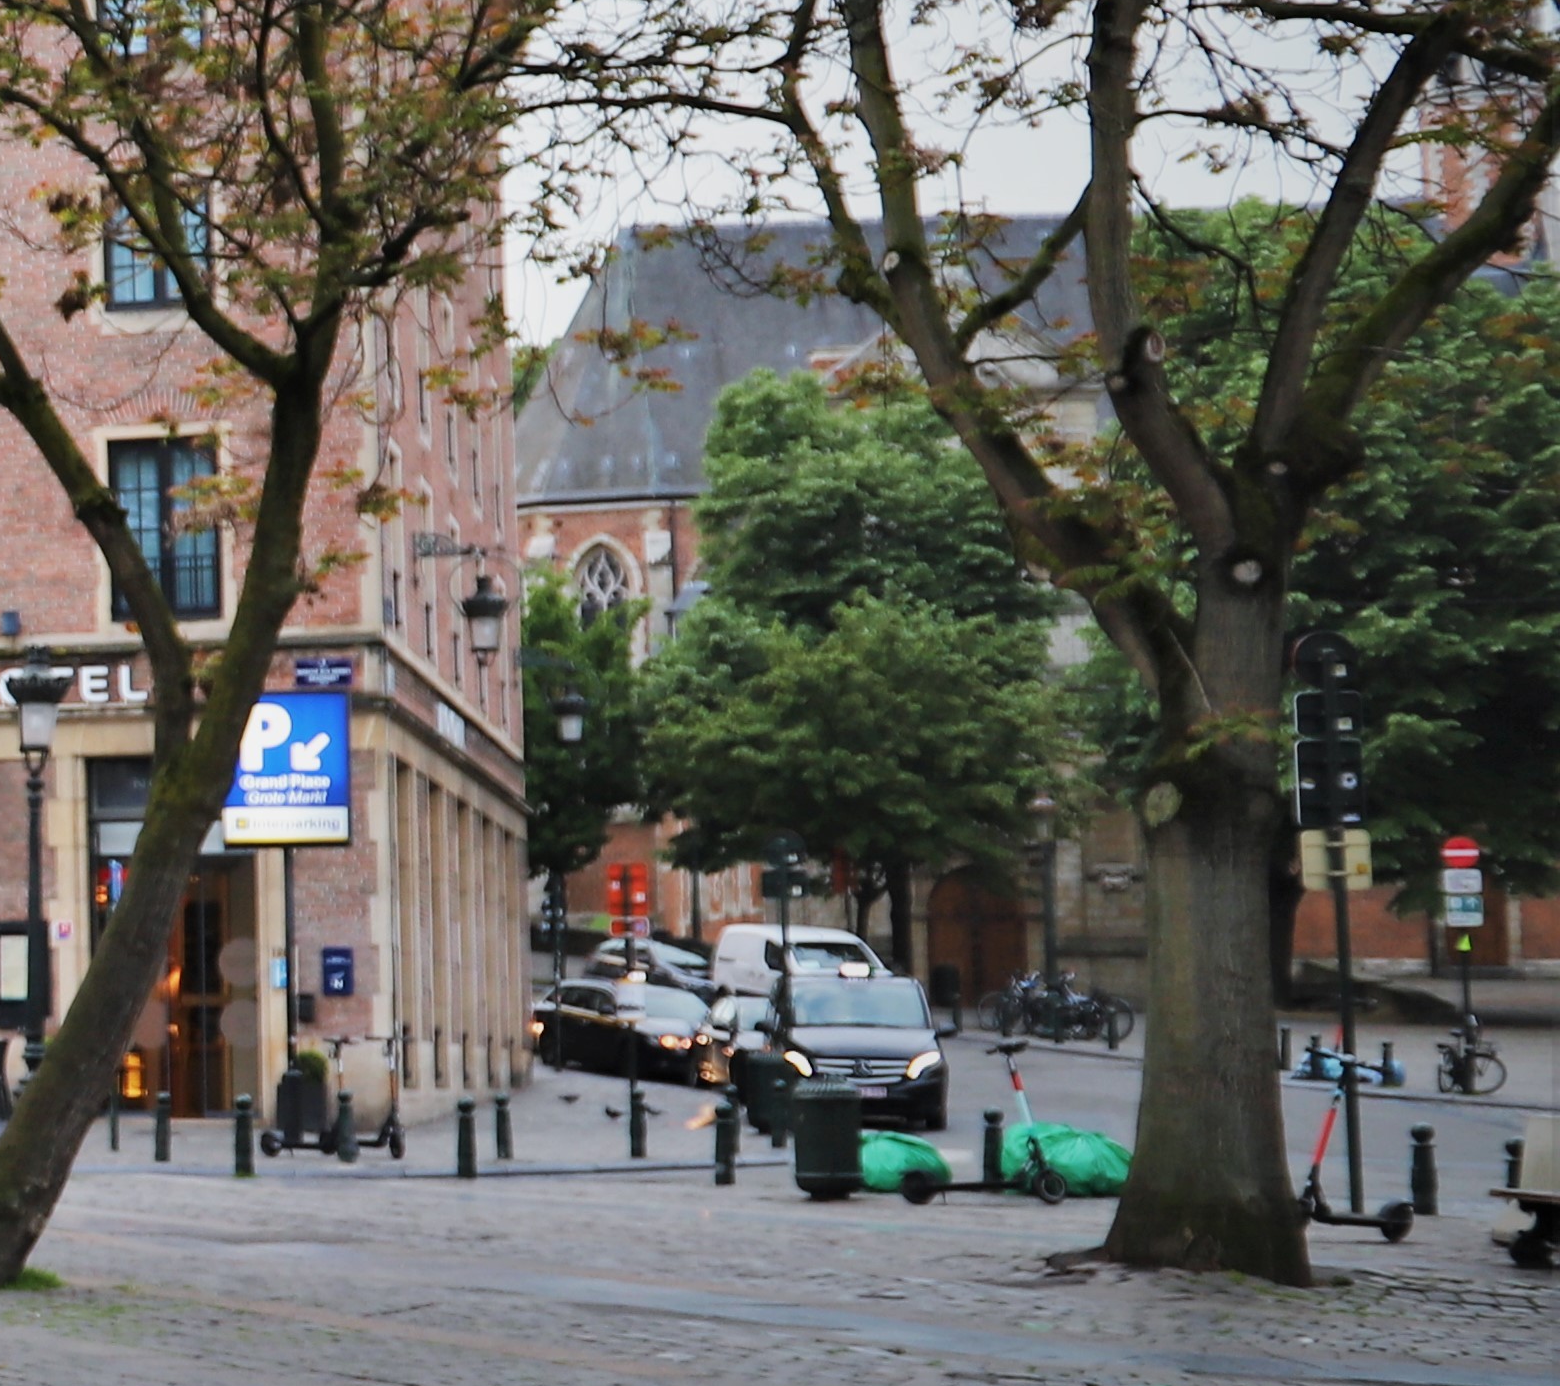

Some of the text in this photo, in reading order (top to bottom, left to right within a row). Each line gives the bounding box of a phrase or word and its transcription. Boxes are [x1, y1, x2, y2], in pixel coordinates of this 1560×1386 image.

[240, 702, 292, 772] P
[240, 773, 331, 791] Grand Place
[288, 790, 328, 805] Markt
